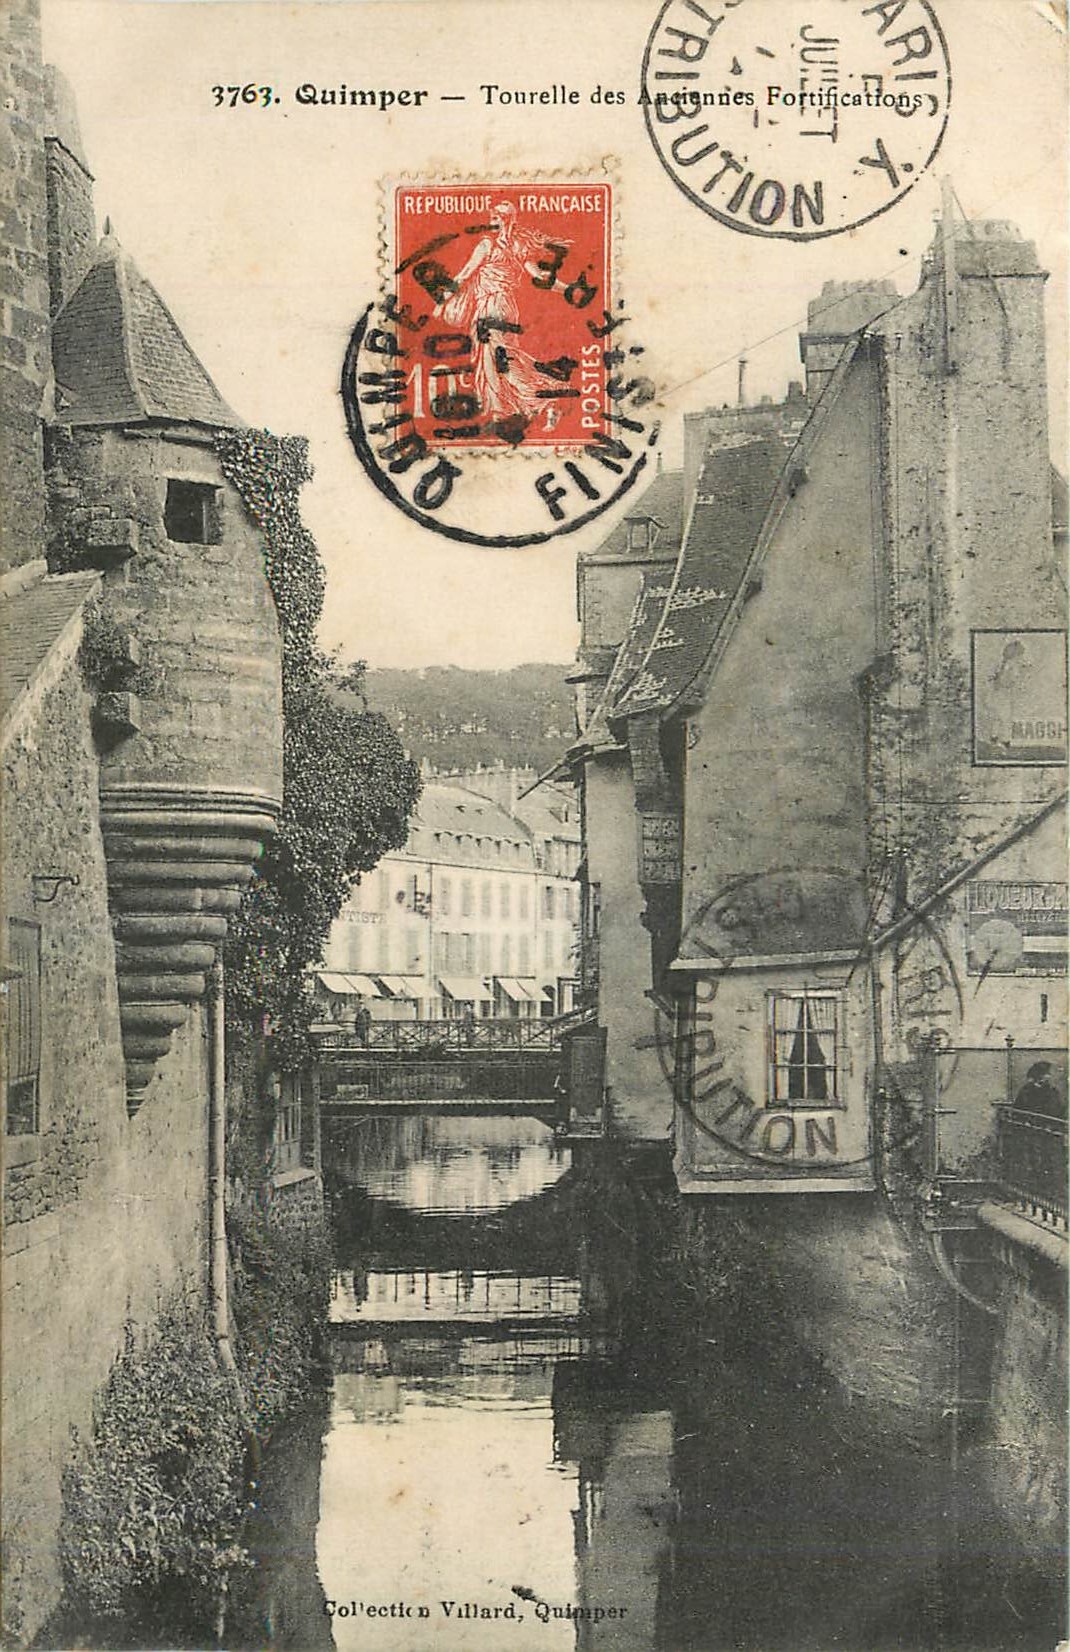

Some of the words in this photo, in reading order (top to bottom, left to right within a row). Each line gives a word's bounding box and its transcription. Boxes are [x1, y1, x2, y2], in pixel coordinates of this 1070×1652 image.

[520, 194, 602, 214] FRANÇAISE
[358, 260, 462, 510] QUIMPER
[581, 344, 601, 429] POSTES
